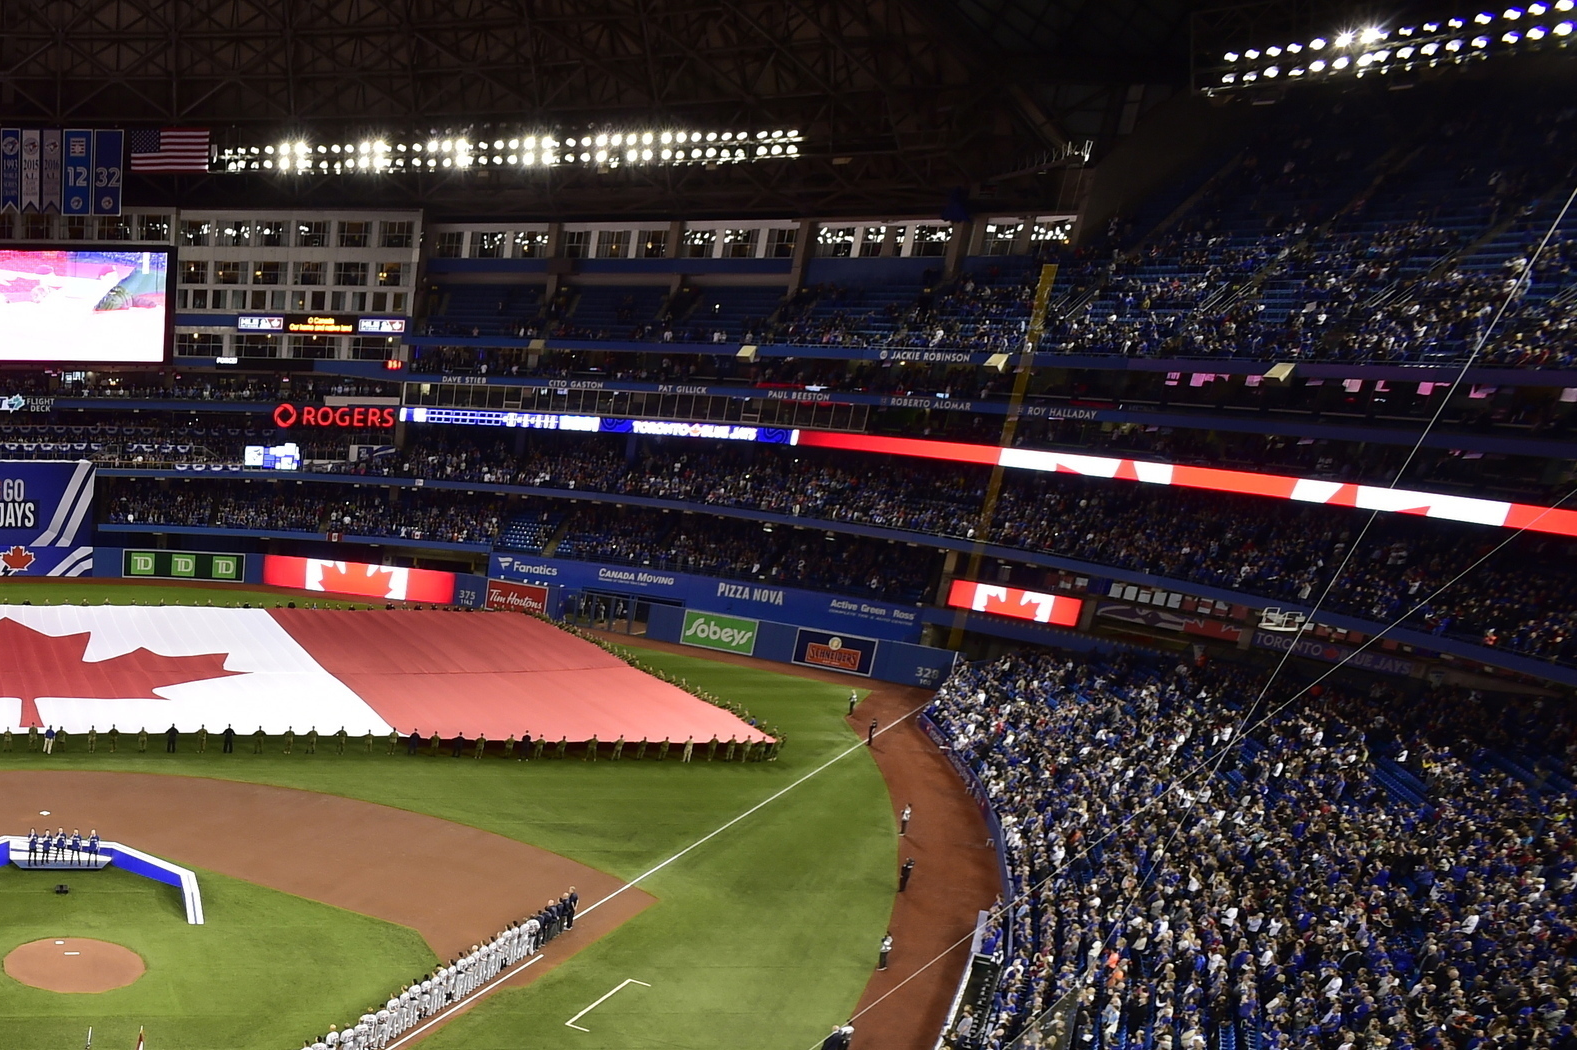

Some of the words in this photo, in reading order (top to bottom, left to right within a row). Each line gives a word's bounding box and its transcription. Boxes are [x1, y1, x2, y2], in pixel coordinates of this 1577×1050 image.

[3, 159, 18, 171] 1993
[23, 159, 39, 171] 2015
[44, 159, 60, 171] 2016
[67, 166, 87, 187] 12
[95, 166, 121, 187] 32
[890, 350, 921, 362] JACKIE
[923, 352, 971, 363] ROBINSON
[442, 375, 462, 383] DAVE
[465, 376, 487, 384] STIEB
[548, 379, 568, 387] CITO
[570, 380, 604, 389] GASTON
[657, 384, 675, 393] PAT
[676, 385, 707, 395] GILLICK
[767, 390, 789, 400] PAUL
[791, 391, 831, 402] BEESTON
[26, 398, 56, 406] FLIGHT
[30, 405, 52, 413] DECK
[890, 397, 931, 409] ROBERTO
[933, 399, 971, 411] ALOMAR
[303, 406, 395, 427] ROGERS
[1027, 405, 1046, 416] ROY
[1048, 407, 1098, 420] HALLADAY
[632, 420, 690, 436] TORONTO
[2, 478, 25, 502] GO
[133, 556, 153, 571] TD
[174, 558, 194, 572] TD
[215, 559, 234, 574] TD
[513, 561, 558, 577] Fanatics
[598, 567, 635, 581] CANADA
[636, 572, 675, 586] MOVING
[458, 589, 476, 600] 375
[489, 589, 509, 603] Tim
[507, 590, 543, 610] Hortons
[717, 582, 750, 601] PIZZA
[752, 589, 783, 606] NOVA
[830, 599, 858, 611] Active
[860, 603, 886, 616] Green
[892, 609, 915, 621] Ross
[684, 617, 754, 647] Sobeys
[807, 646, 857, 668] SCHNEIDERS
[1254, 632, 1323, 658] TORONTO
[1337, 648, 1374, 670] BLUE
[1374, 656, 1411, 675] JAYS
[914, 666, 940, 680] 328
